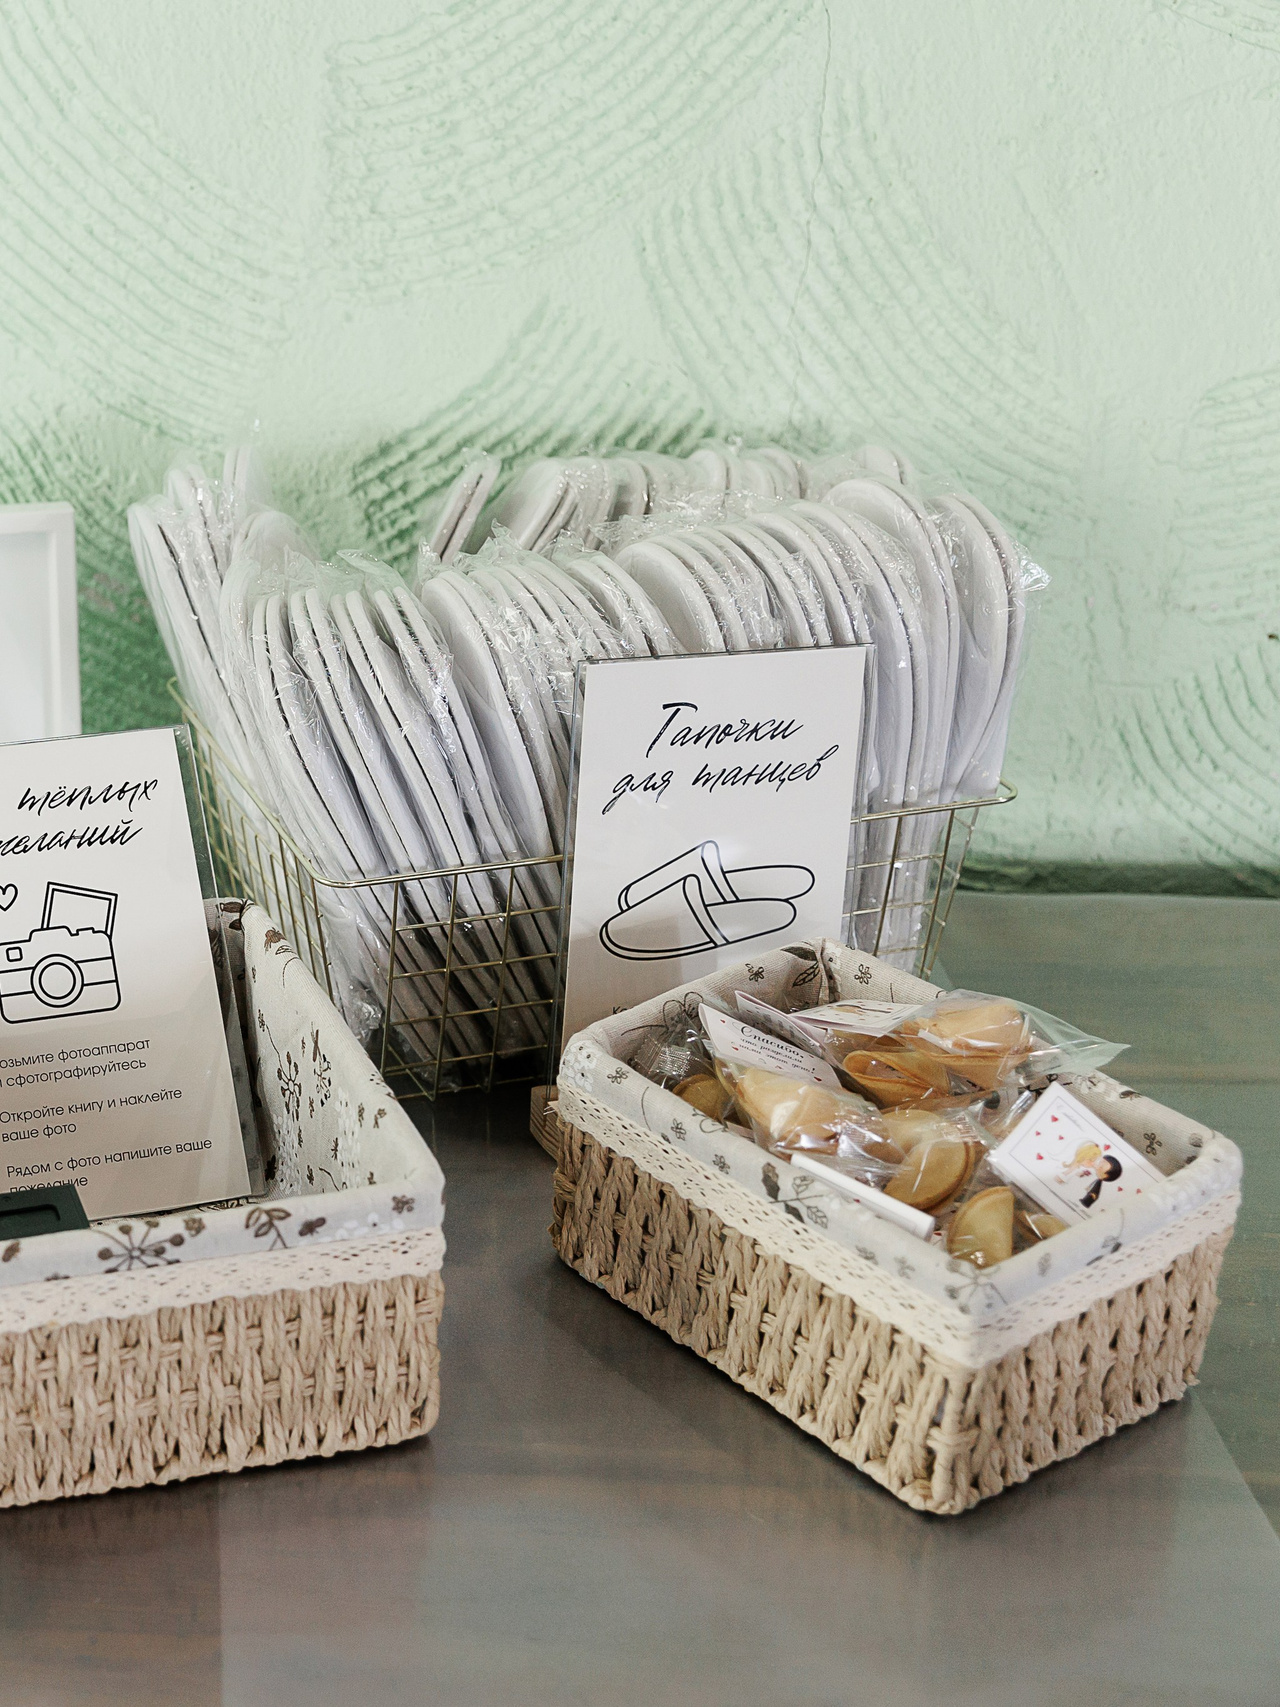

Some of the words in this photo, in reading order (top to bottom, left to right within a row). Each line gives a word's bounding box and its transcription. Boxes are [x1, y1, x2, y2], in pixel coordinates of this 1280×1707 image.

[646, 701, 804, 758] Тапочки
[17, 778, 158, 816] тёплых
[601, 769, 674, 815] для
[691, 744, 839, 793] танцев
[58, 1039, 150, 1063] фотоаппарат
[738, 1024, 804, 1059] Спасибо,
[6, 1058, 147, 1088] сфотографируйтесь
[68, 1098, 104, 1115] книгу
[107, 1097, 116, 1109] и
[119, 1088, 183, 1108] наклейте
[1, 1128, 39, 1143] ваше
[43, 1122, 77, 1140] фото
[6, 1163, 51, 1178] Рядом
[54, 1160, 64, 1171] с
[67, 1153, 101, 1171] фото
[104, 1145, 172, 1163] напишите
[175, 1138, 213, 1154] ваше
